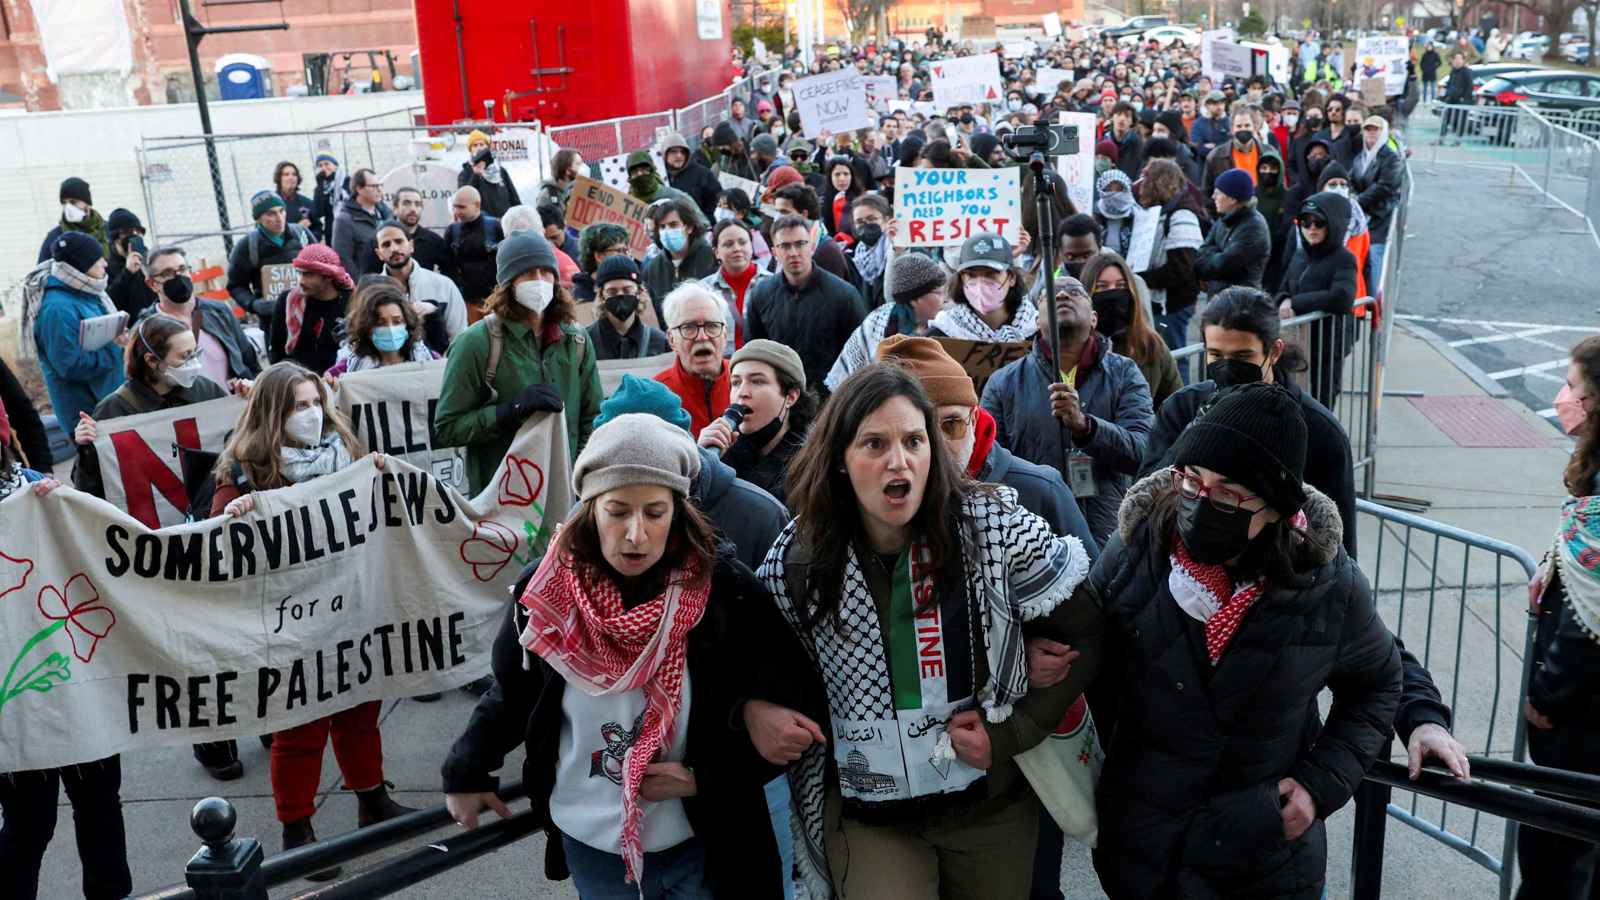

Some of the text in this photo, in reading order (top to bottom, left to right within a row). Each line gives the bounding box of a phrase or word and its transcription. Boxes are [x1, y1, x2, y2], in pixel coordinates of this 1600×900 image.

[816, 96, 849, 117] NOW
[913, 169, 967, 186] YOUR
[587, 186, 614, 207] END
[960, 204, 991, 215] YOU
[909, 217, 1009, 243] RESIST
[105, 473, 456, 582] SOMERVILLE JEWS
[274, 594, 343, 634] for a
[127, 611, 465, 734] FREE PALESTINE
